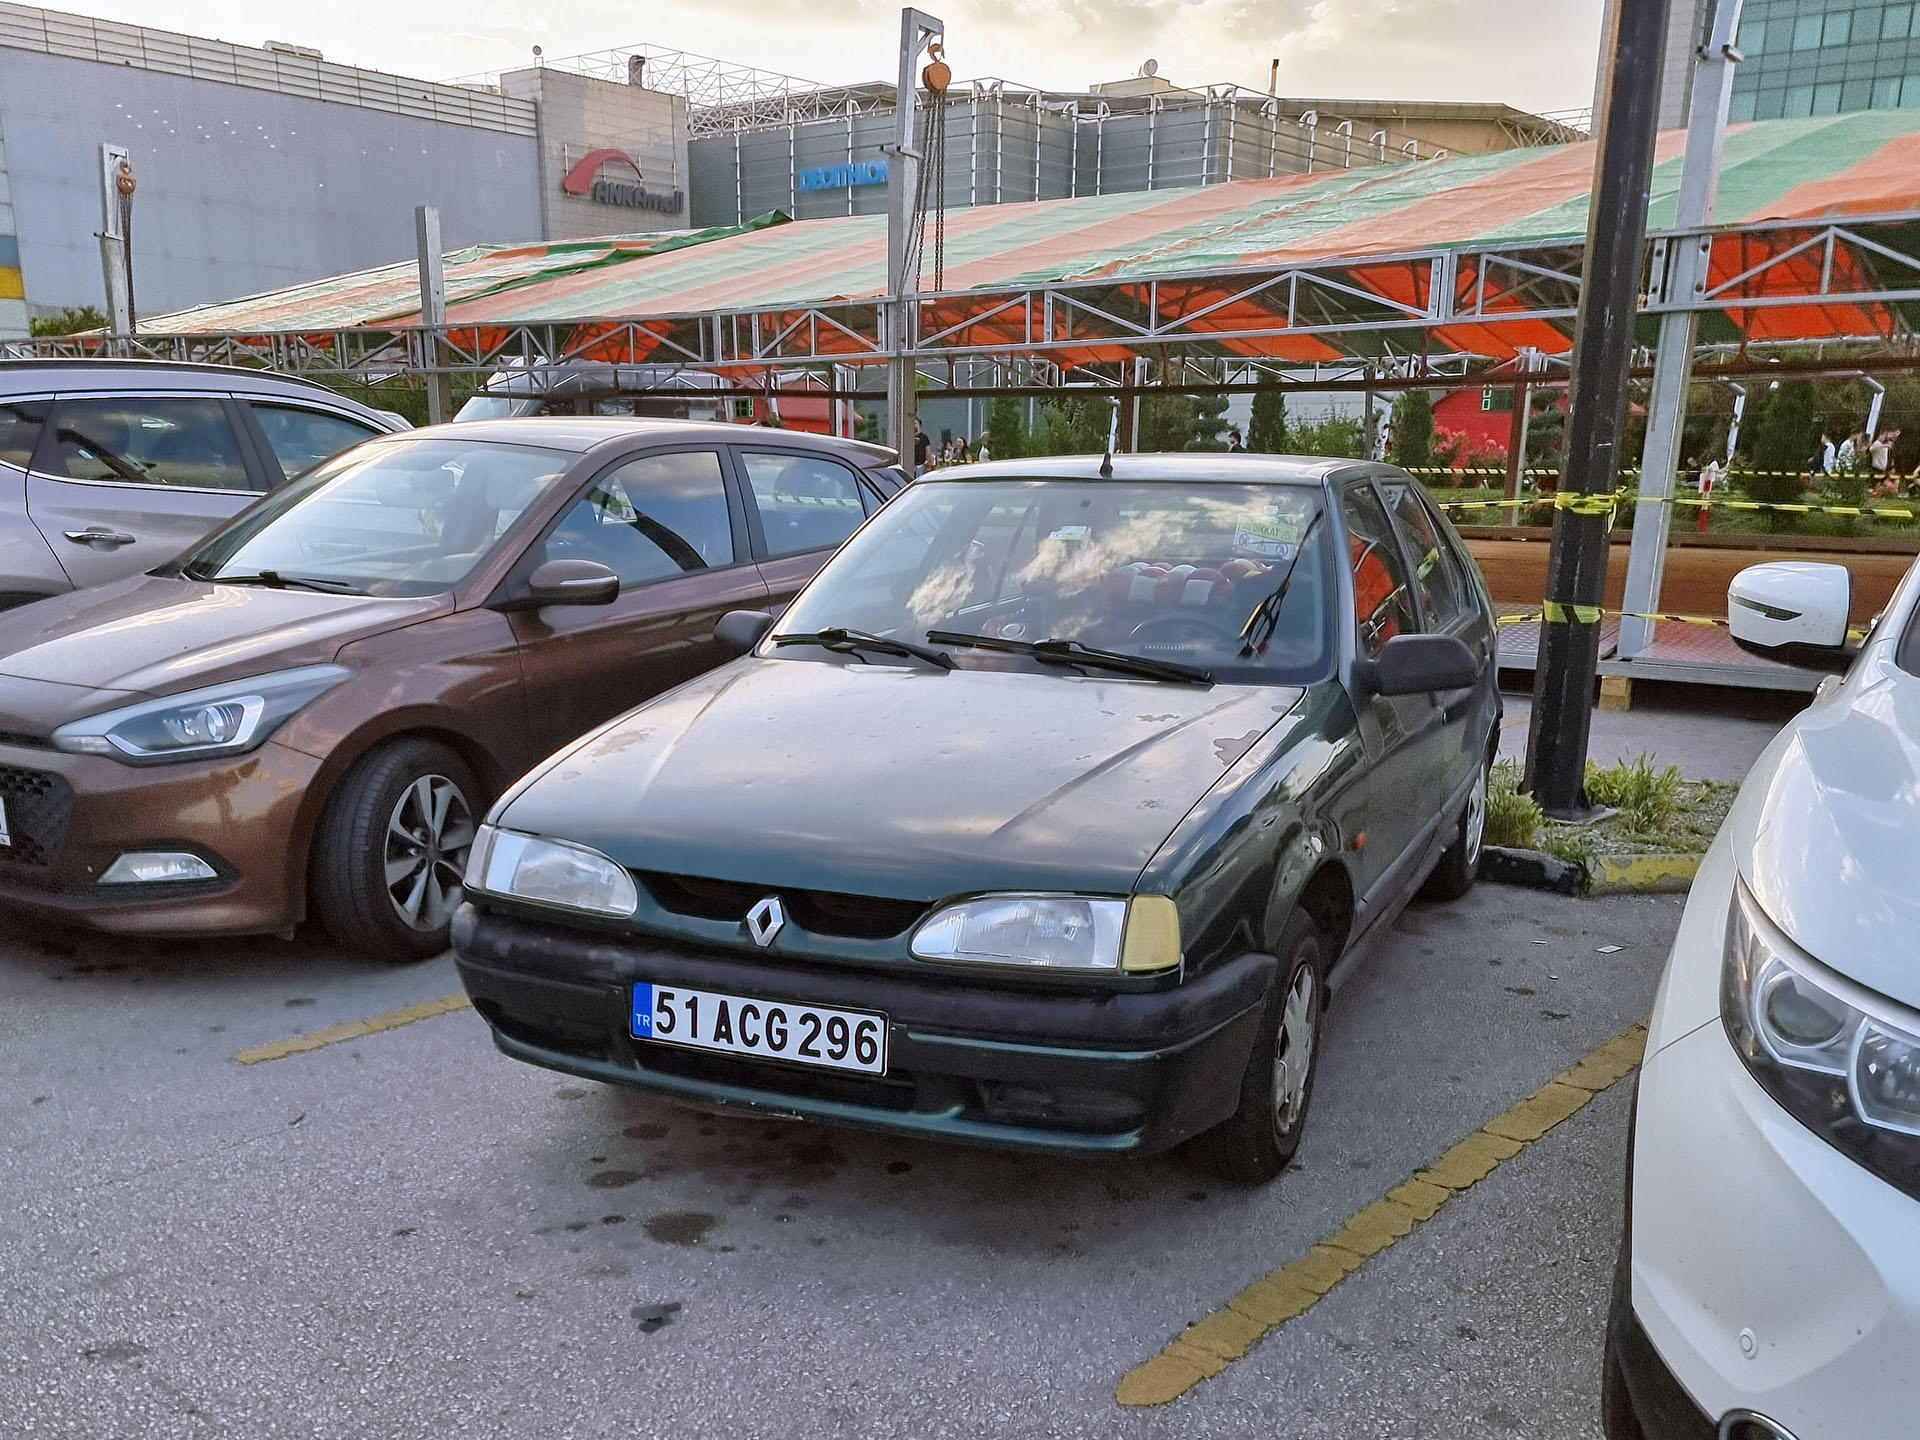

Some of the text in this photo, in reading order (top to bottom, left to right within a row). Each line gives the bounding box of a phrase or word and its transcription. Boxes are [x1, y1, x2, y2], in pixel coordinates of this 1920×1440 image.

[636, 1013, 650, 1028] TR
[656, 991, 878, 1066] 51 ACG 296
